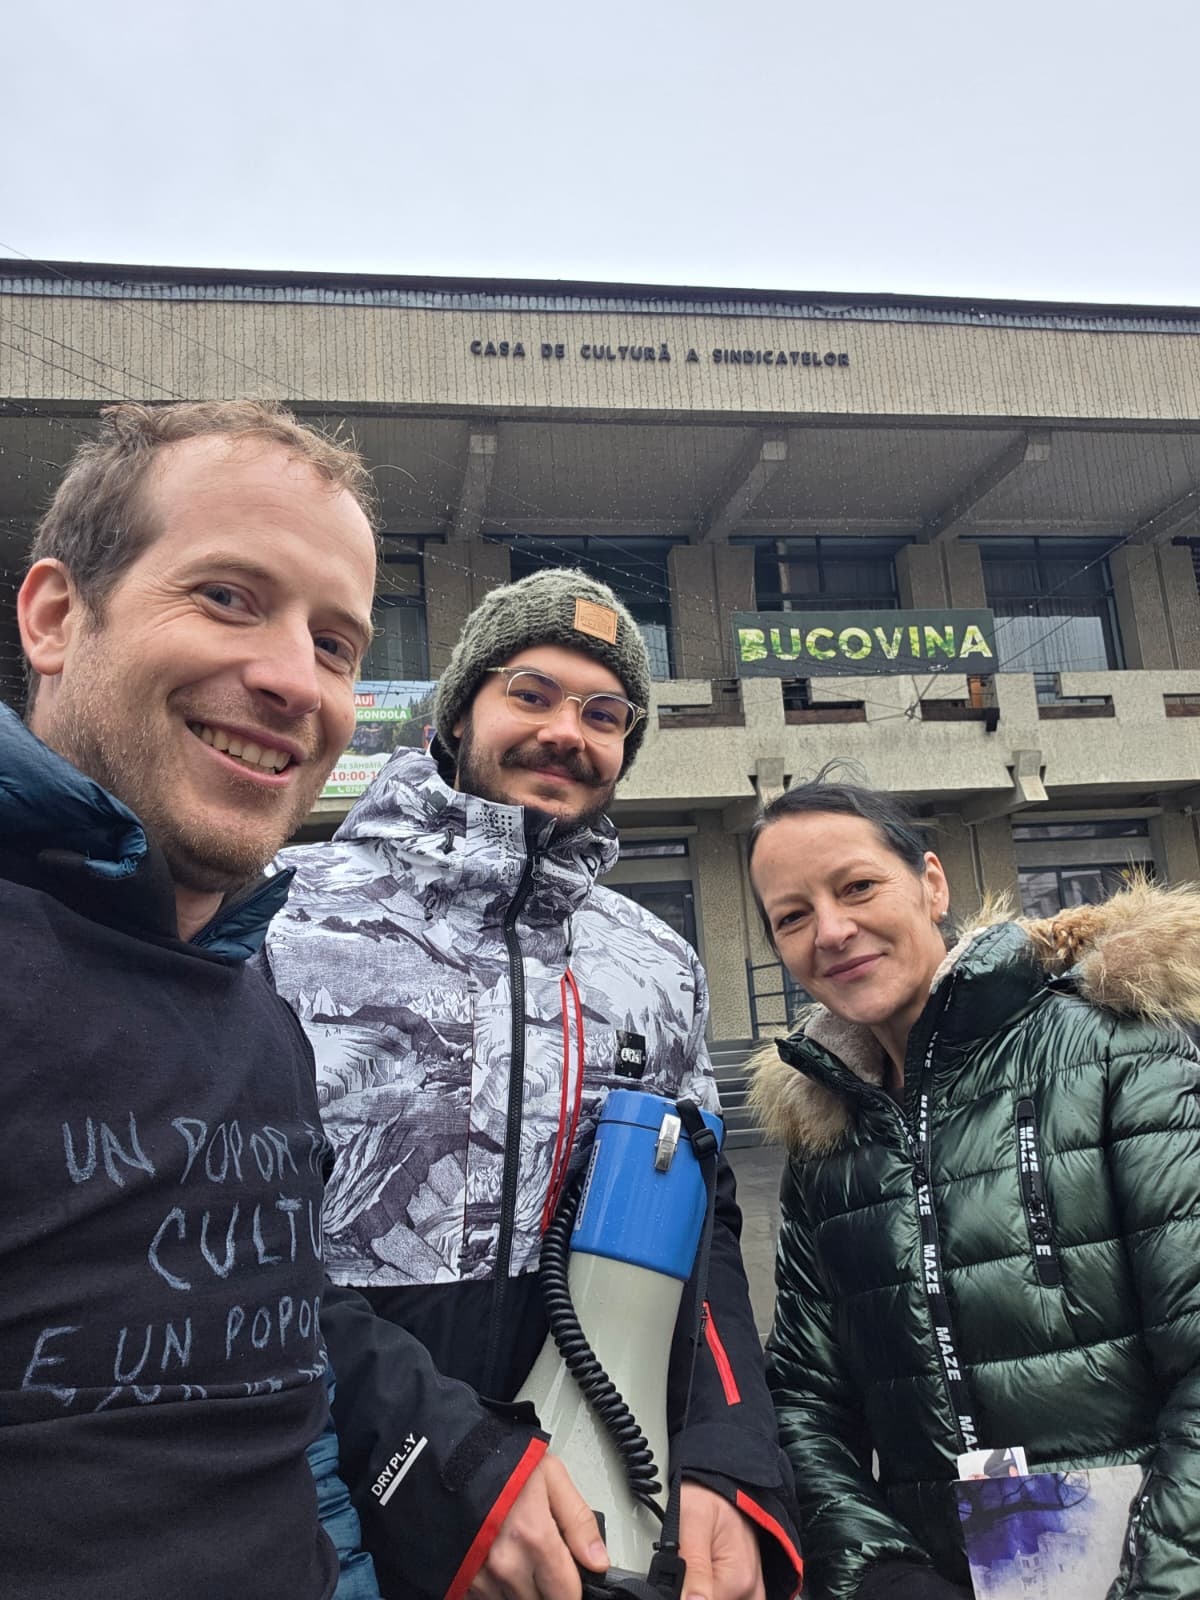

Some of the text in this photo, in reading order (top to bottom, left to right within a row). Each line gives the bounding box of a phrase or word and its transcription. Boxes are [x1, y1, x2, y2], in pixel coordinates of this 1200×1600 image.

[470, 340, 850, 367] CASA DE CULTURĂ A SINDICATELOR
[738, 625, 993, 662] BUCOVINA
[62, 1111, 156, 1188] UN
[1019, 1126, 1040, 1173] MAZE
[923, 1244, 940, 1294] MAZE
[21, 1326, 83, 1397] E
[114, 1317, 193, 1383] UN
[935, 1326, 961, 1381] MAZE
